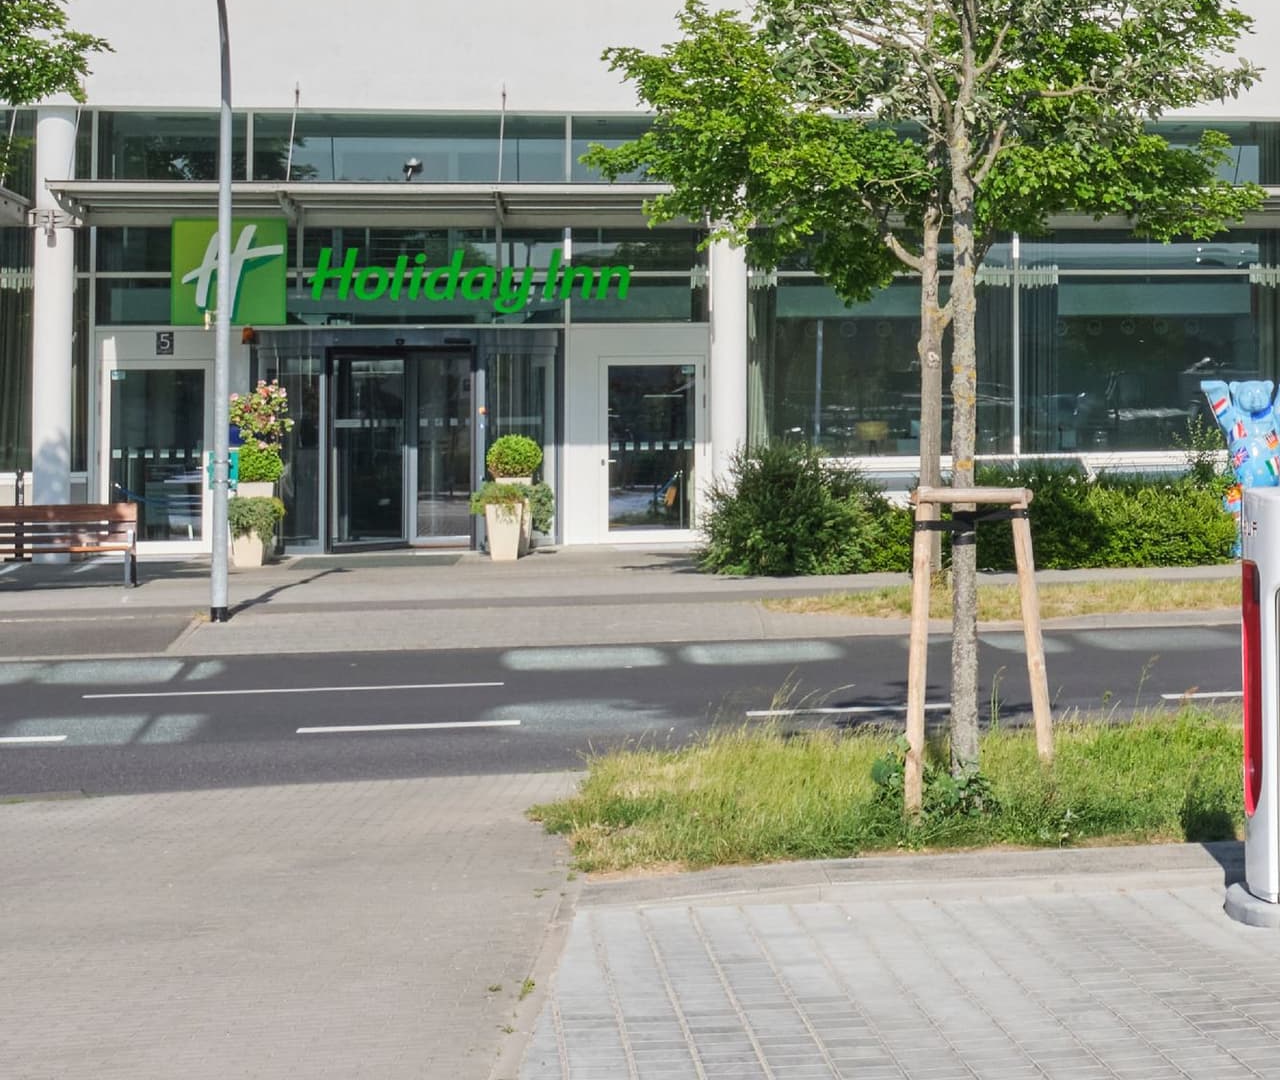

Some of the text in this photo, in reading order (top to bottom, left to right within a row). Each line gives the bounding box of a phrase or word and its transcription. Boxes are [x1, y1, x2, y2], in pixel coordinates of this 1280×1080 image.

[307, 247, 632, 313] Holiday Inn
[160, 333, 170, 350] 5
